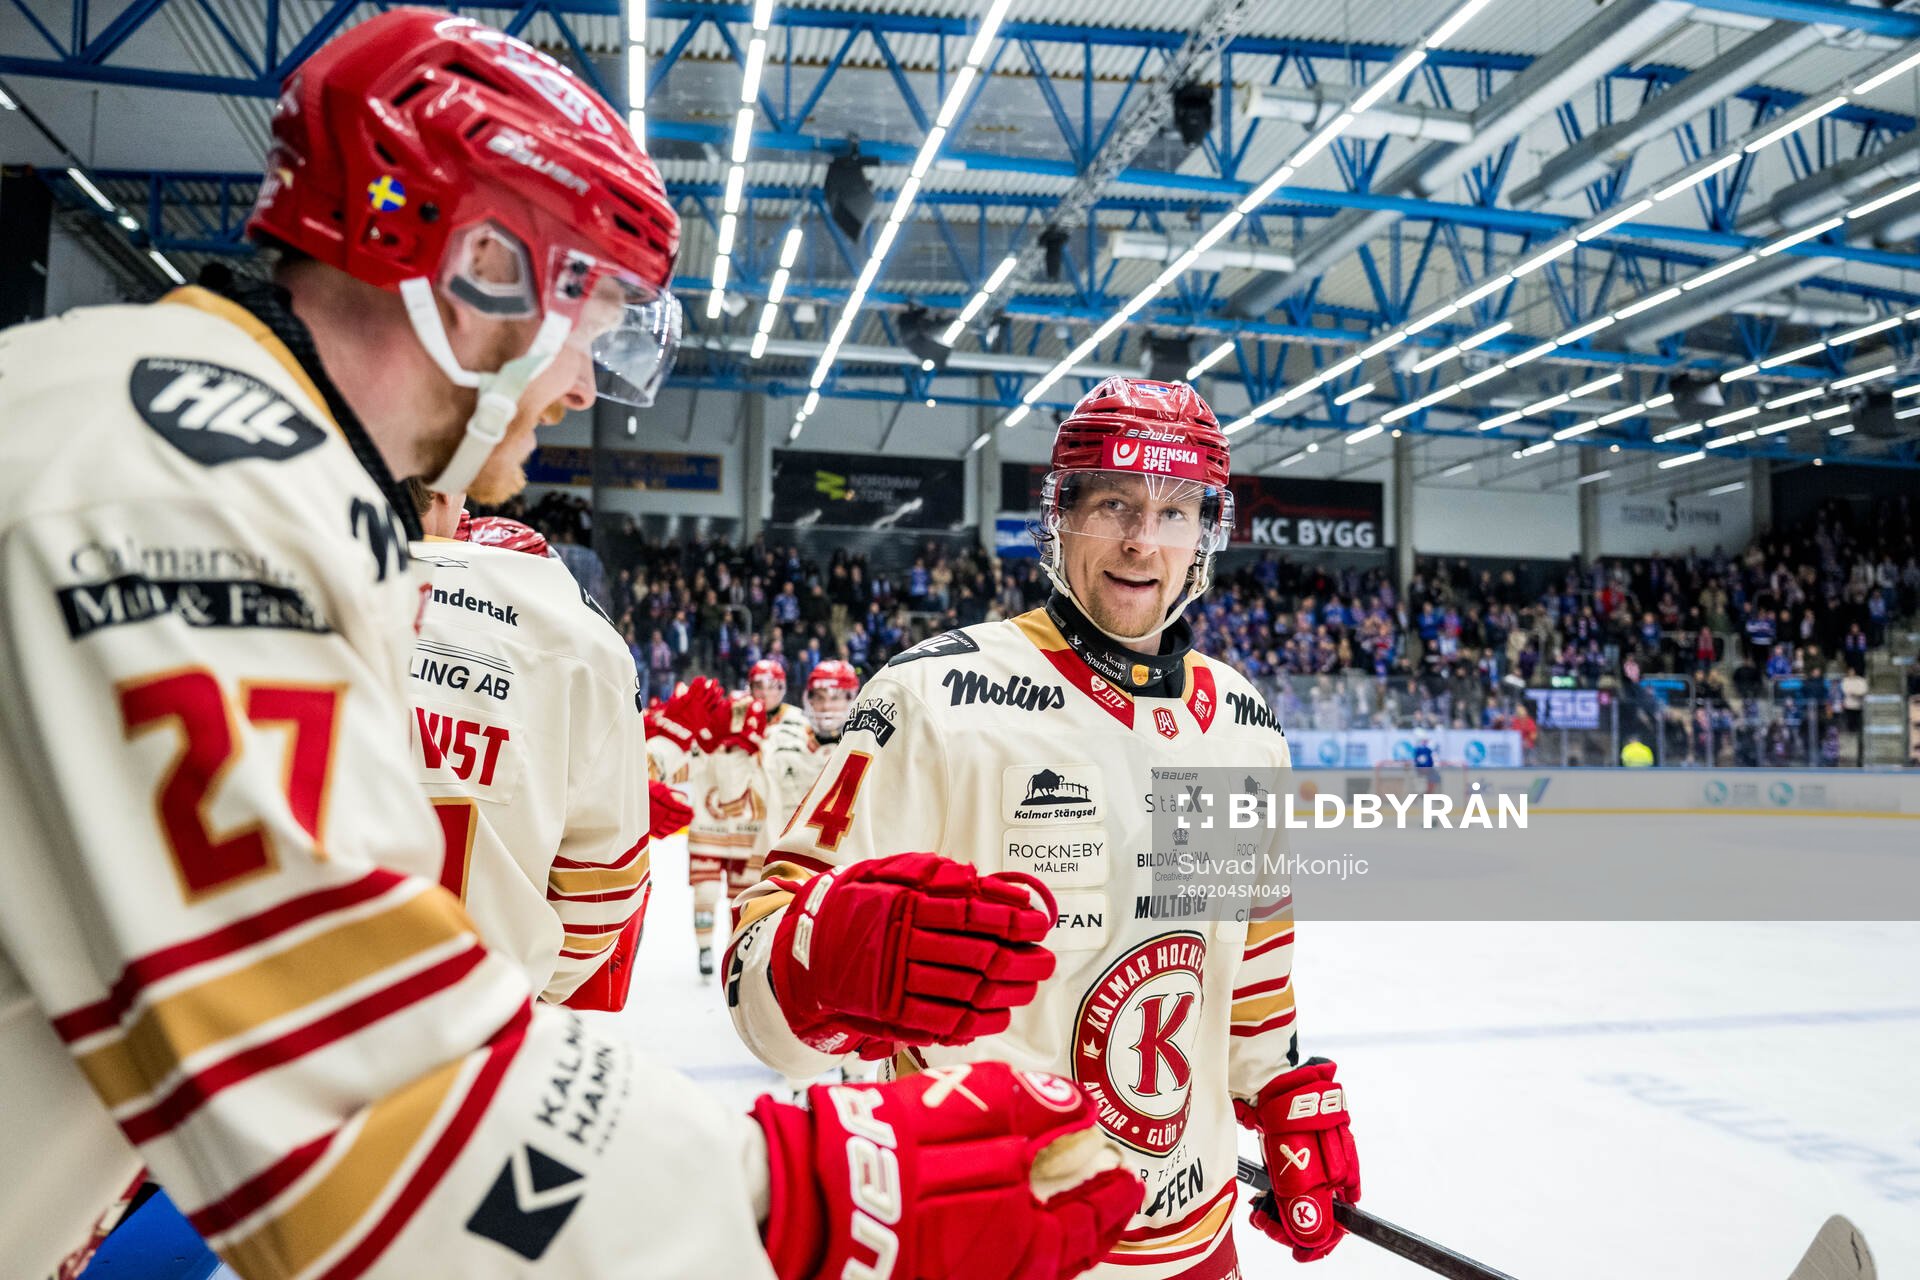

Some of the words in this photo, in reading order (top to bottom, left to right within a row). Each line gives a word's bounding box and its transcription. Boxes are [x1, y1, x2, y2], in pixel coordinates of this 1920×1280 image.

[1125, 429, 1185, 443] BAUER
[1142, 458, 1172, 472] SPEL
[1144, 445, 1198, 464] SVENSKA
[1251, 517, 1290, 545] KC
[1299, 518, 1376, 548] BYGG
[1084, 651, 1124, 682] Sparbank
[474, 673, 510, 700] AB
[942, 668, 1065, 711] Molins
[410, 707, 510, 786] VIST
[115, 665, 349, 905] 27
[1161, 771, 1198, 781] BAUER
[781, 750, 874, 850] 4
[1014, 810, 1052, 820] Kalmar
[1054, 807, 1096, 819] Stängsel
[1009, 843, 1104, 859] ROCKNEBY
[1034, 861, 1079, 873] MÅLERI
[1086, 954, 1151, 1034] KALMAR
[1128, 992, 1195, 1096] K
[1146, 1122, 1177, 1147] GLÖD
[1297, 1206, 1314, 1225] K
